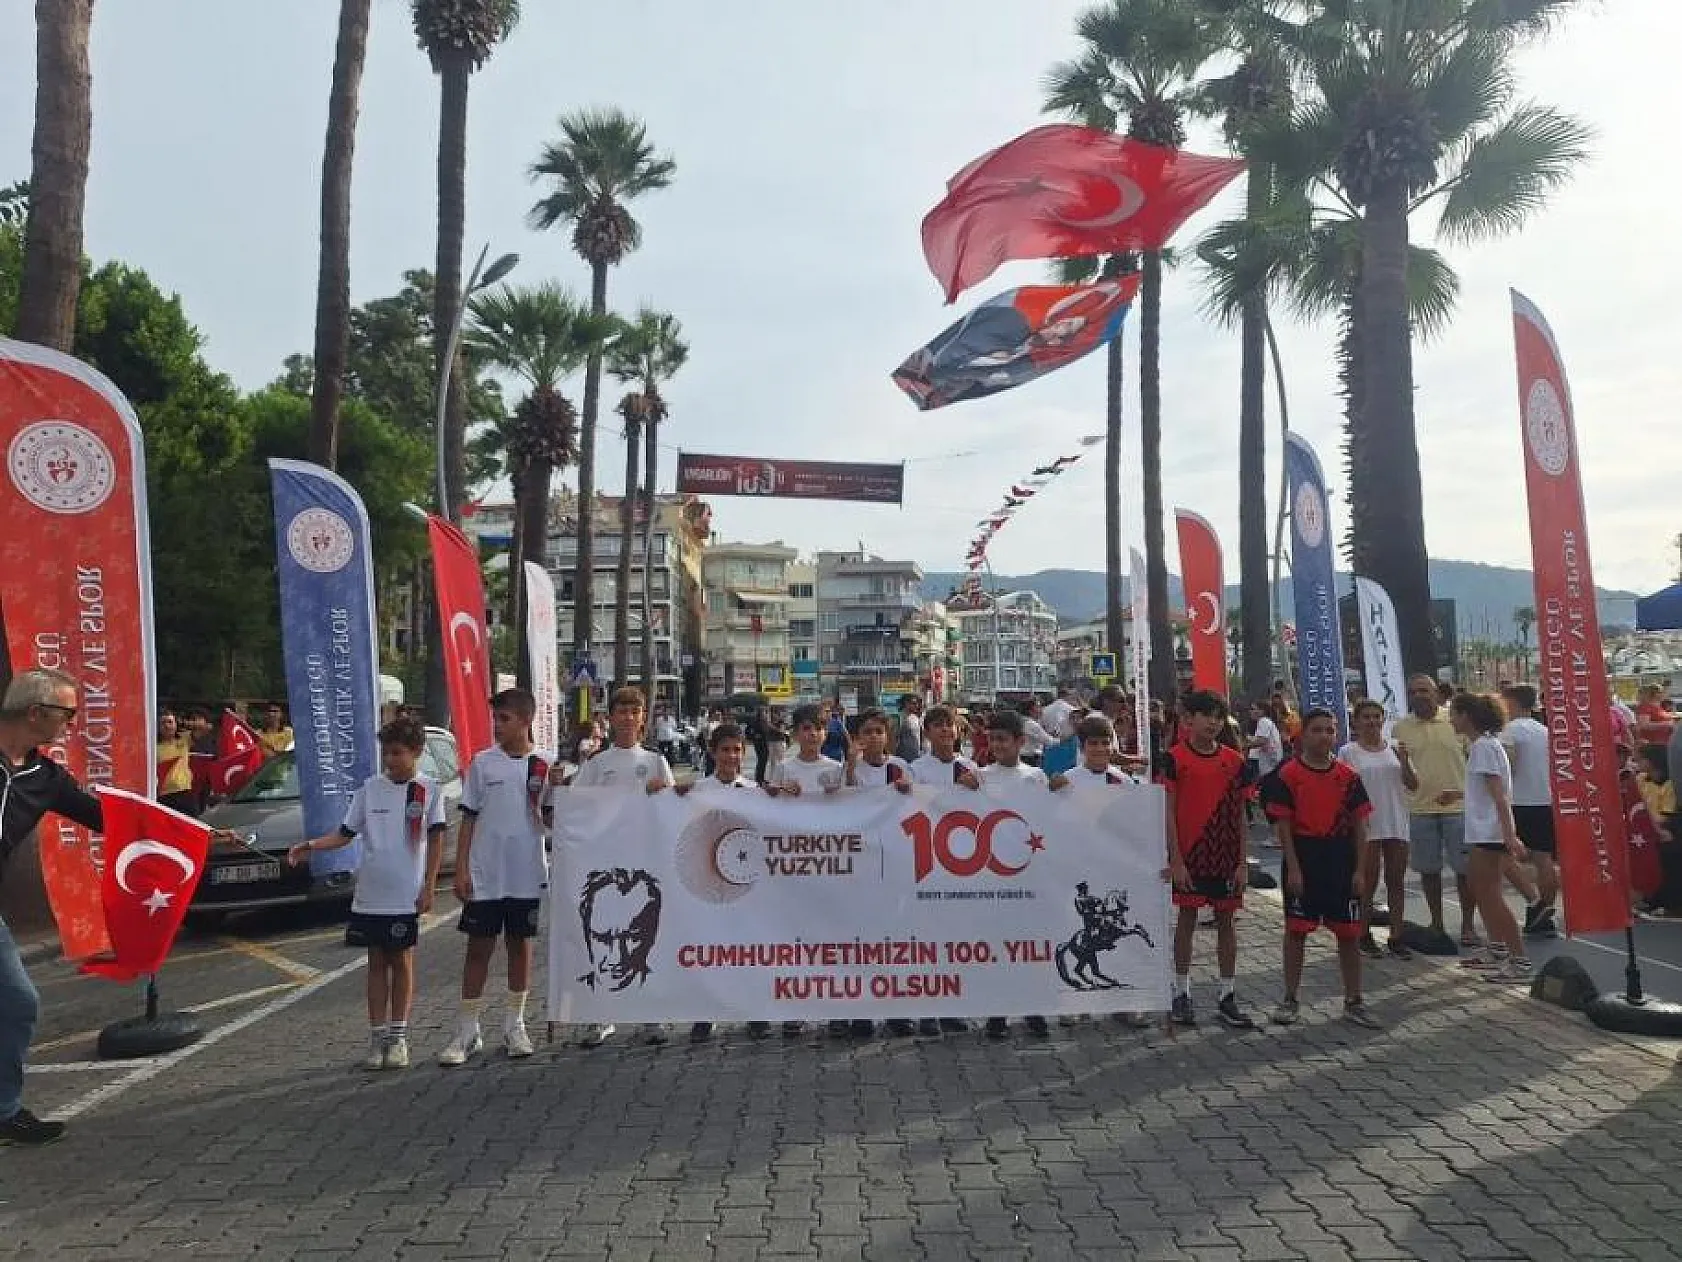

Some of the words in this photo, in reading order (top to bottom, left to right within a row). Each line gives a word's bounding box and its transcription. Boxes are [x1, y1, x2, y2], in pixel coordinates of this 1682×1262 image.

[678, 936, 938, 967] CUMHURİYETİMİZİN
[944, 940, 998, 964] 100.
[1003, 940, 1052, 963] YILI
[774, 974, 863, 1000] KUTLU
[870, 973, 961, 998] OLSUN
